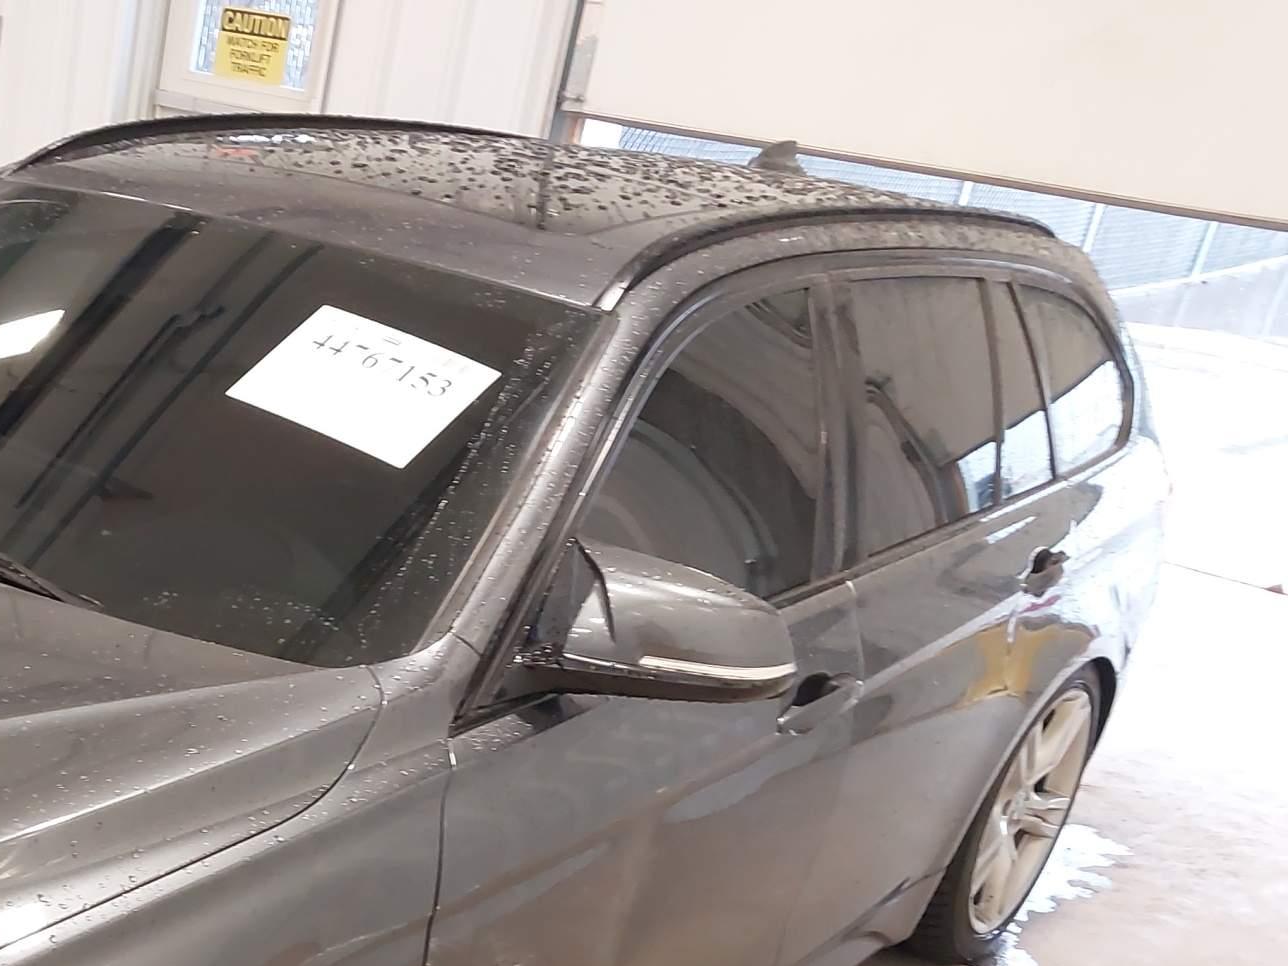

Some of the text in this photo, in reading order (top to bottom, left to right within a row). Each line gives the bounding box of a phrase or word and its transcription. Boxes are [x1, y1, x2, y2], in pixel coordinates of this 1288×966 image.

[223, 11, 288, 39] CAUTION
[227, 36, 280, 52] WATCH FOR
[231, 48, 272, 63] FORKLIFT
[231, 61, 267, 77] TRAFFIC
